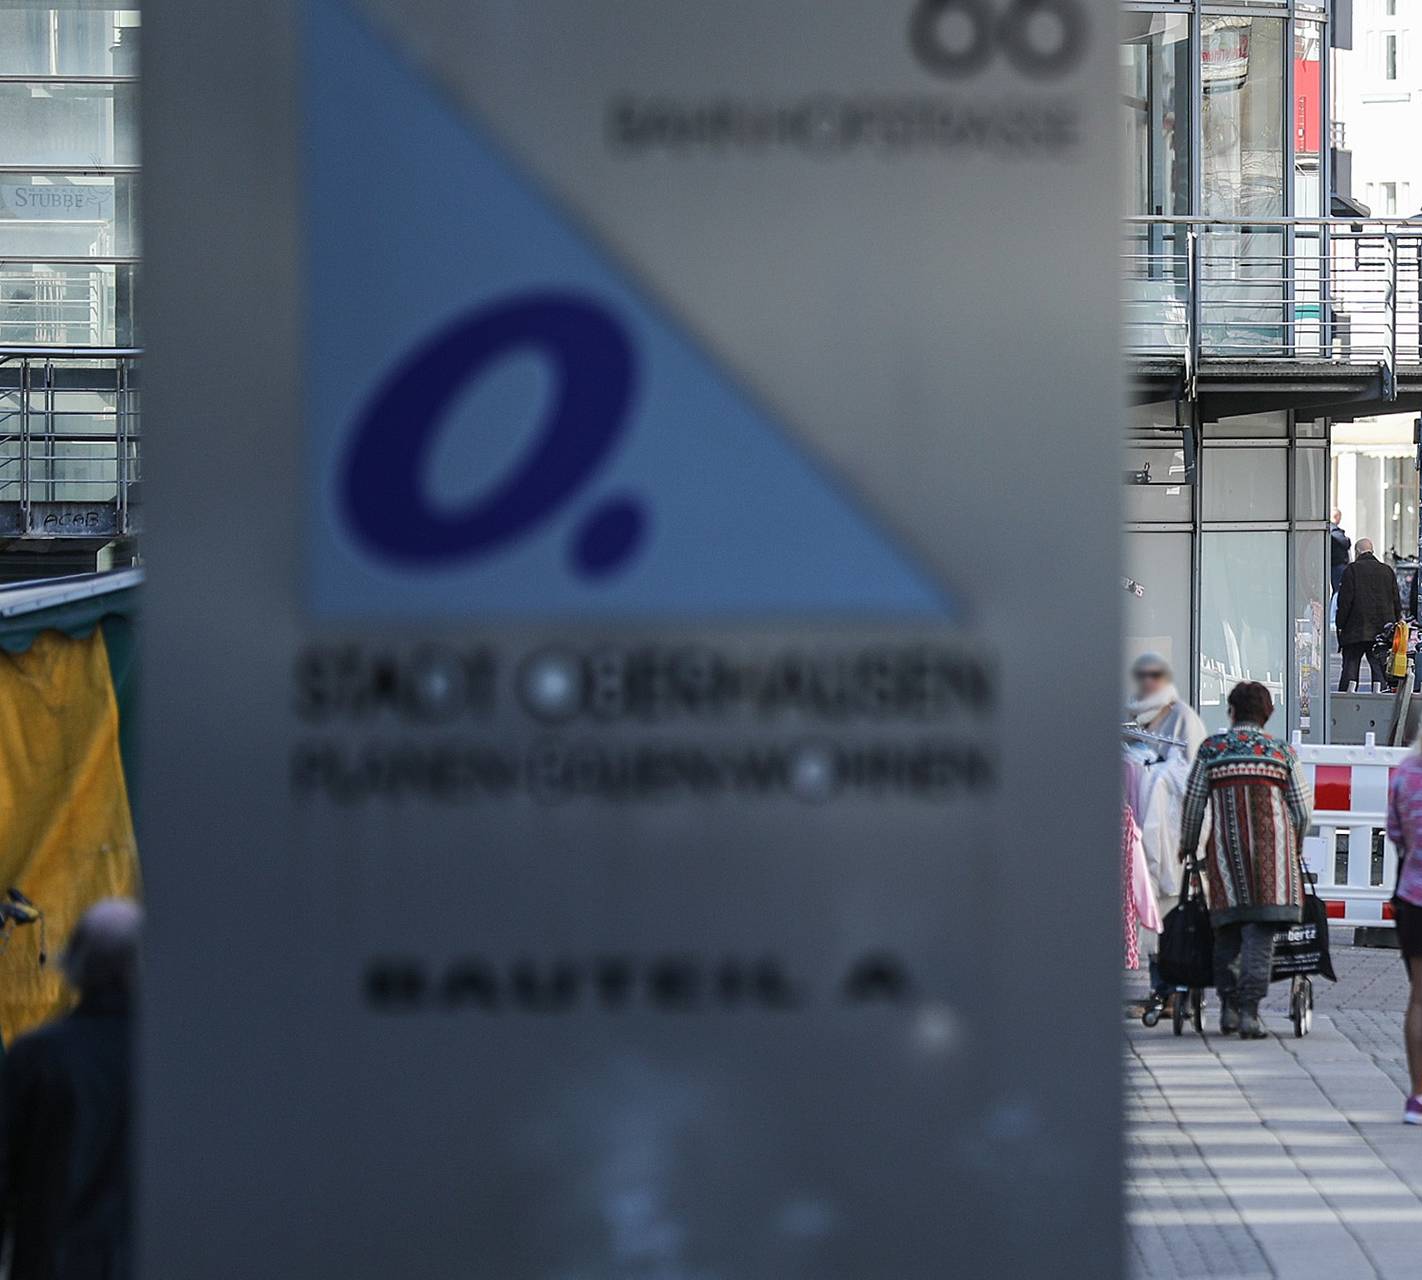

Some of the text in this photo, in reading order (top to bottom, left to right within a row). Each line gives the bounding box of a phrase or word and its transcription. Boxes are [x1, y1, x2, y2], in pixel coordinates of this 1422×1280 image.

[15, 187, 84, 208] STUBBE
[43, 511, 99, 527] ACAB
[293, 648, 996, 719] STADT OBERHAUSEN
[363, 953, 914, 1011] BAUTEIL A
